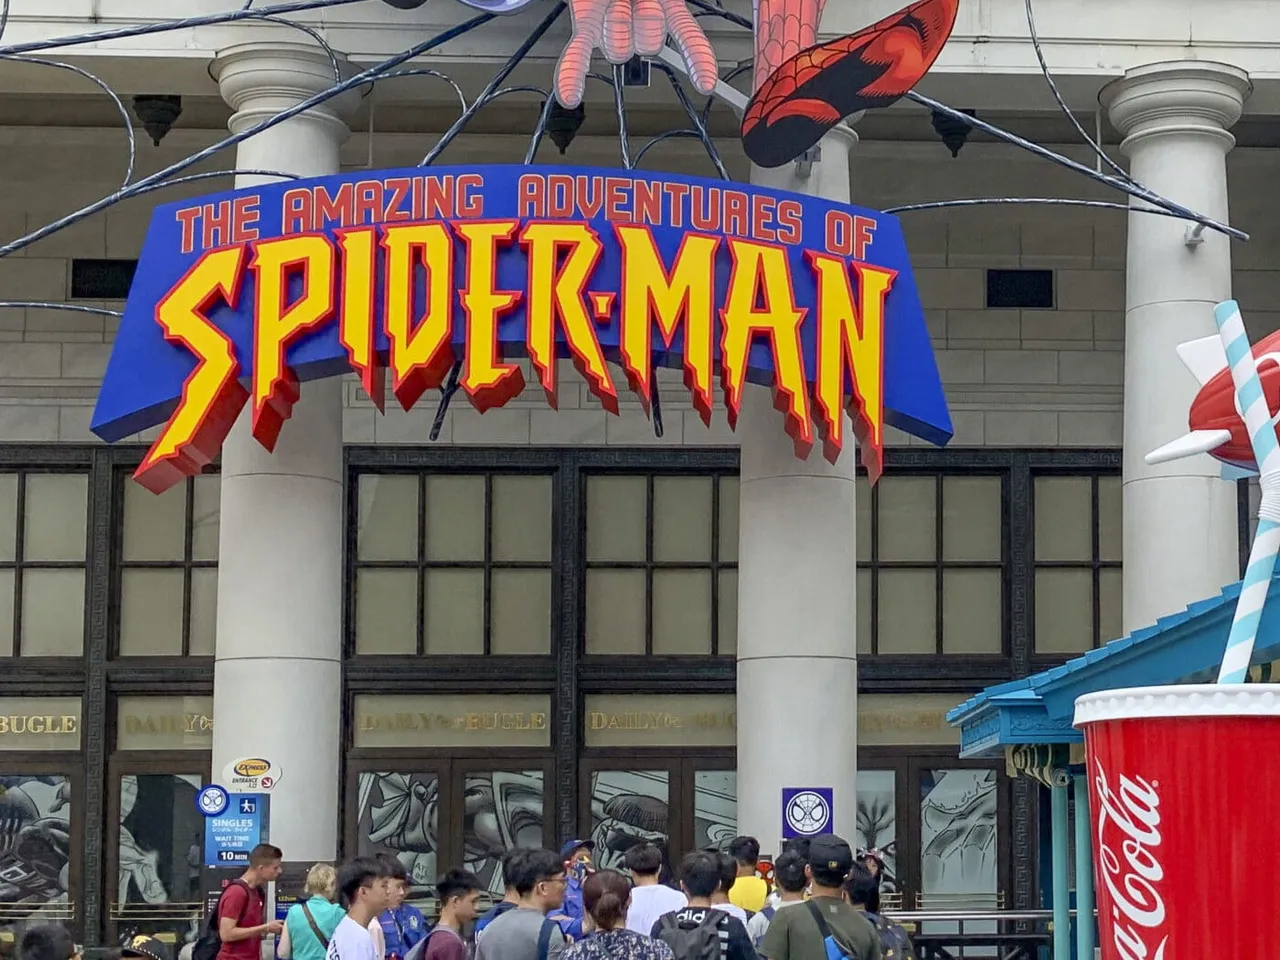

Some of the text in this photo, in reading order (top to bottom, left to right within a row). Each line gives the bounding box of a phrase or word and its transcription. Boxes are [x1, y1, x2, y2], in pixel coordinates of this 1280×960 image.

[176, 173, 877, 261] THE AMAZING ADVENTURES OF
[211, 819, 253, 827] SINGLES
[220, 851, 234, 861] 10
